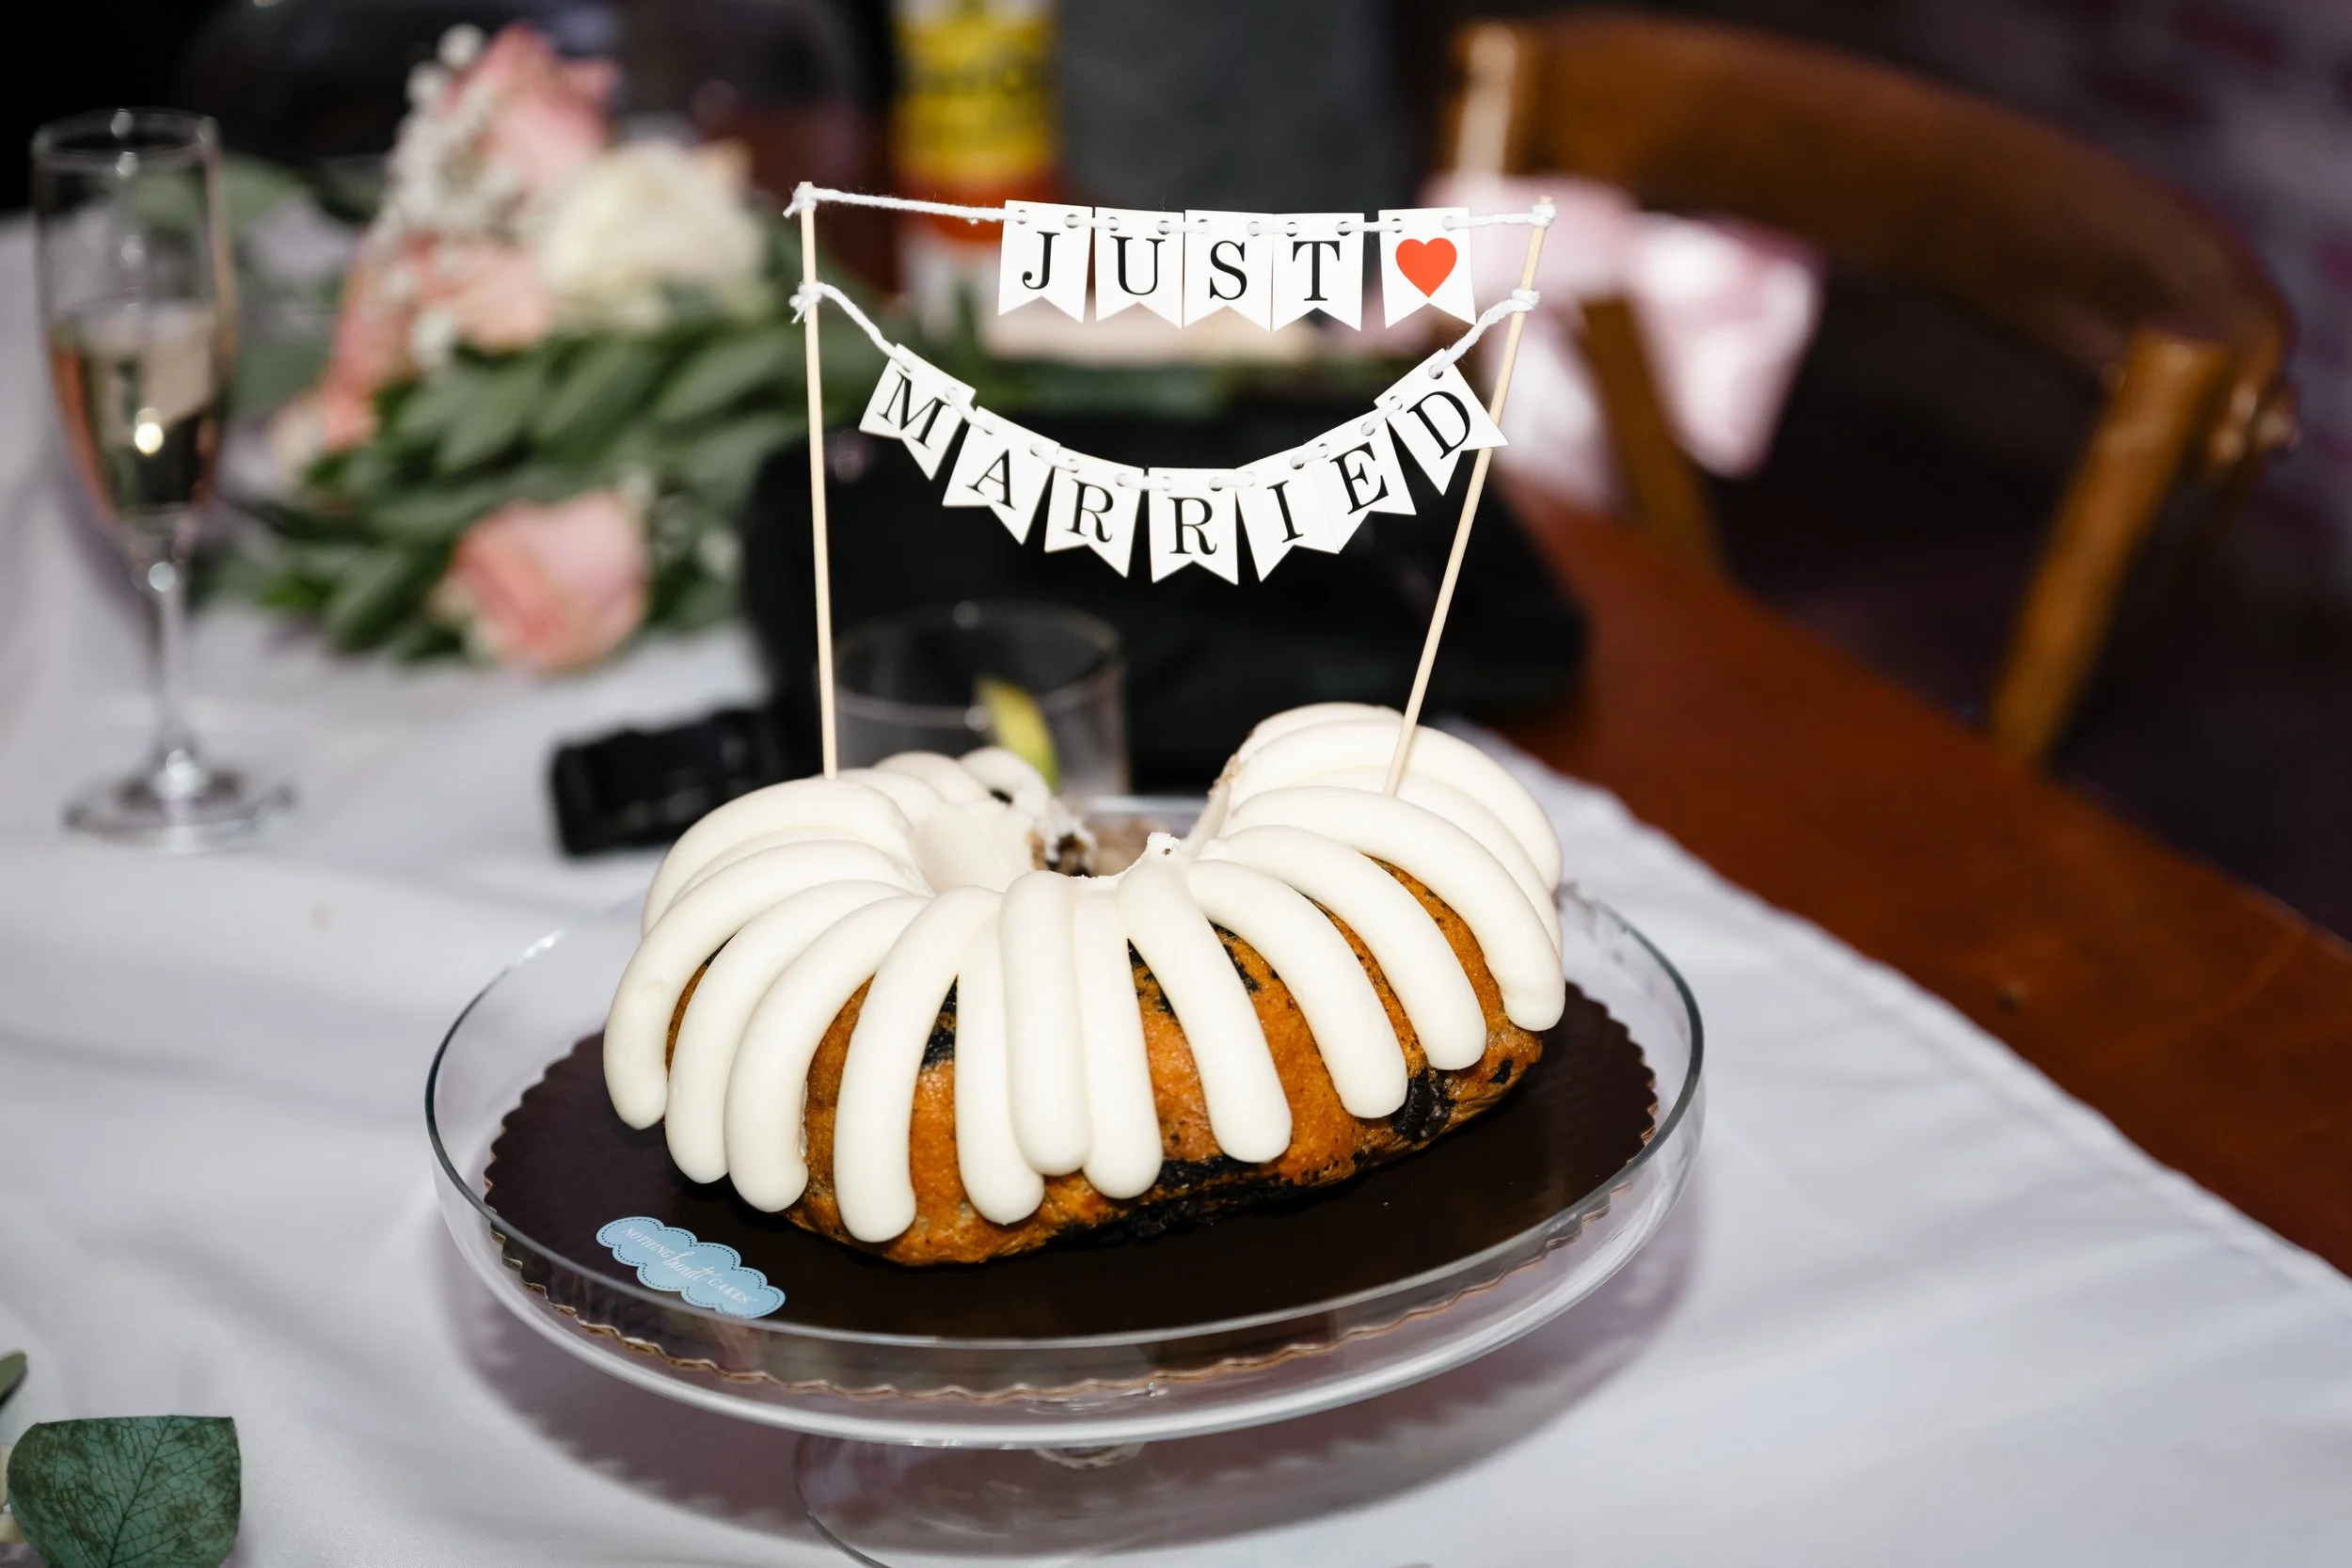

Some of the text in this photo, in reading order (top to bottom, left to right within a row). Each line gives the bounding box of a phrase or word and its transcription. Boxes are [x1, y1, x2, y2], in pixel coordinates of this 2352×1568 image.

[1022, 230, 1342, 301] JUST
[877, 371, 1471, 556] MARRIED
[623, 1227, 752, 1304] NOTHING bundt CAKES
